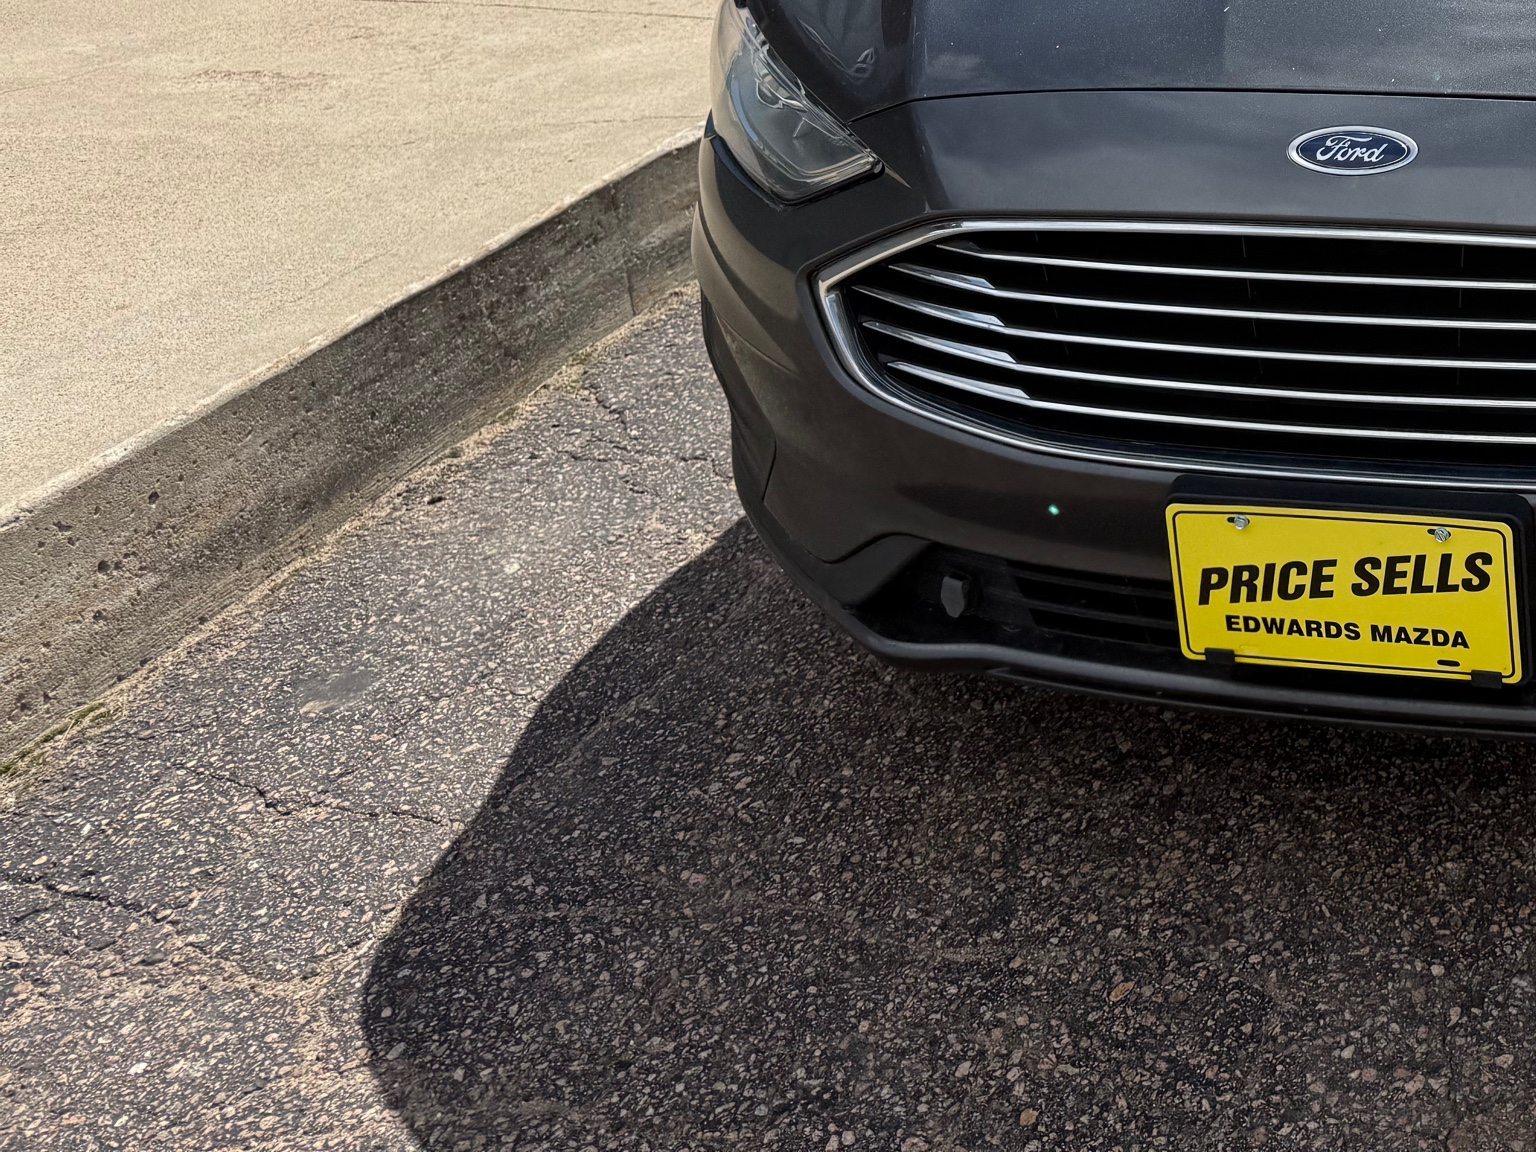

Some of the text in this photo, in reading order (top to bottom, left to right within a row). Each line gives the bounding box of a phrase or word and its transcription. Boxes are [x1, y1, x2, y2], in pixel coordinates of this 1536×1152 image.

[1316, 135, 1389, 163] Ford
[1198, 551, 1493, 606] PRICE SELLS
[1225, 614, 1470, 649] EDWARDS MAZDA
